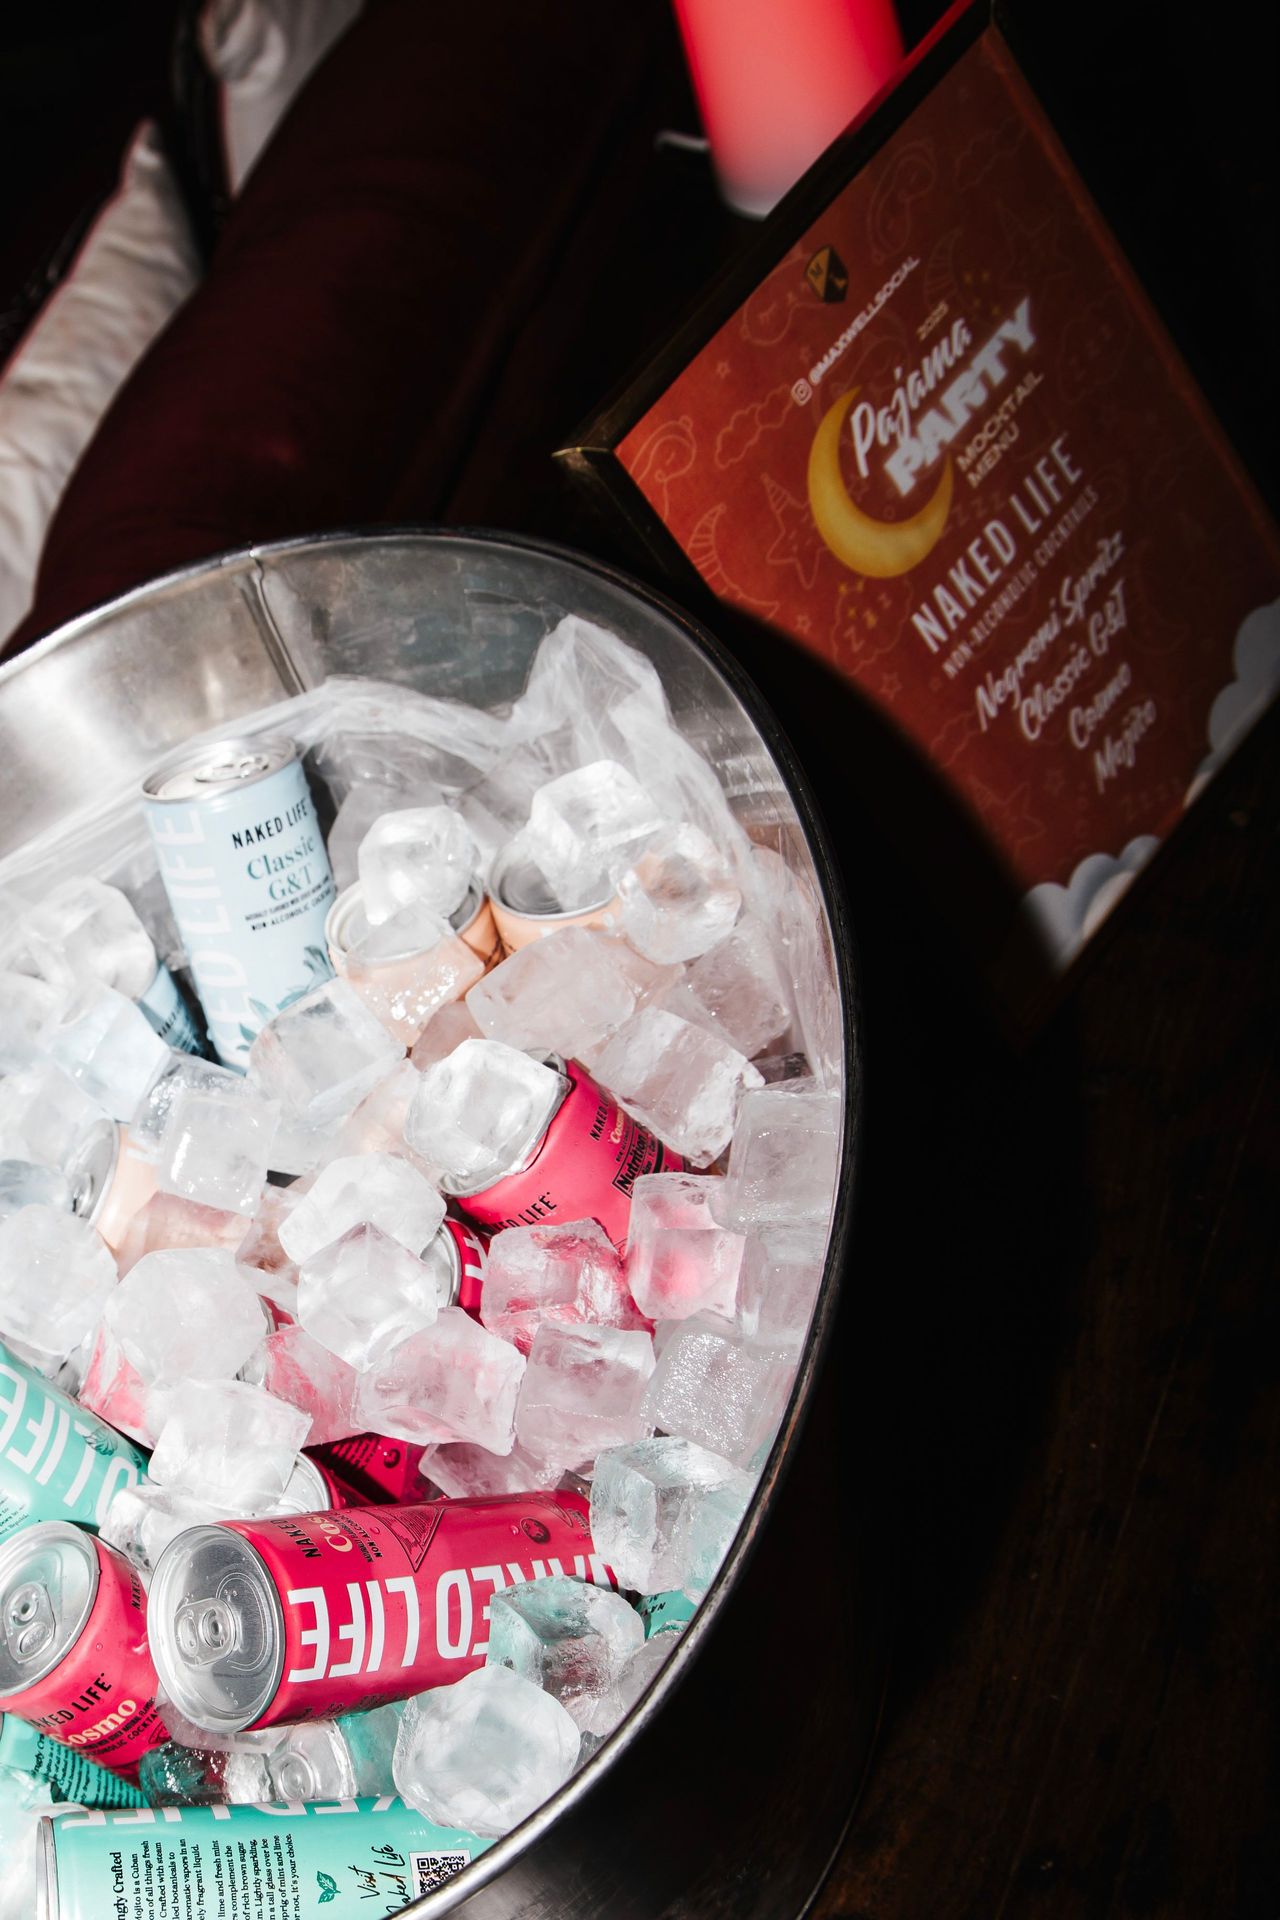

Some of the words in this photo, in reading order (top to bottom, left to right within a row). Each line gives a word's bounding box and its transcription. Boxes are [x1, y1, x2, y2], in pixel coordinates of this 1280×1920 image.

[850, 318, 972, 478] Pajama
[884, 296, 1036, 496] PARTY
[955, 372, 1044, 470] MOCKTAIL
[967, 423, 1020, 487] MENU
[911, 519, 1016, 654] NAKED
[1010, 437, 1082, 534] LIFE
[976, 598, 1060, 732] Negroni
[1020, 642, 1091, 741] Classic
[231, 815, 284, 850] NAKED
[285, 798, 309, 827] LIFE
[246, 835, 315, 880] Classic
[146, 808, 231, 935] LIFE
[268, 862, 313, 902] G&T
[616, 1134, 648, 1191] Nutrition
[518, 1195, 557, 1225] LIFE
[270, 1519, 322, 1559] NAKED
[287, 1576, 421, 1683] LIFE
[30, 1709, 75, 1729] AKED
[71, 1676, 113, 1713] LIFE
[127, 1709, 158, 1740] COCKTA
[141, 1840, 151, 1859] fresh
[155, 1842, 164, 1864] steam
[180, 1839, 186, 1847] an
[212, 1840, 220, 1857] mint
[225, 1845, 233, 1857] the
[237, 1841, 247, 1862] sugar
[273, 1835, 282, 1850] lime
[371, 1844, 405, 1867] Life
[131, 1853, 139, 1879] Cuban
[169, 1852, 175, 1860] to
[191, 1844, 202, 1868] liquid.
[213, 1858, 223, 1878] fresh
[263, 1850, 272, 1867] over
[274, 1851, 284, 1866] and
[290, 1859, 300, 1878] your
[109, 1852, 125, 1894] Crafted
[144, 1860, 153, 1885] things
[156, 1865, 165, 1883] with
[168, 1861, 179, 1904] botanicals
[182, 1856, 191, 1883] vapors
[240, 1863, 249, 1890] brown
[266, 1868, 276, 1890] glass
[278, 1867, 286, 1888] mint
[348, 1865, 380, 1899] Visit
[145, 1887, 154, 1897] all
[195, 1869, 205, 1906] fragrant
[215, 1880, 224, 1896] and
[228, 1859, 239, 1911] complement
[253, 1877, 264, 1907] Lightly
[278, 1888, 286, 1897] of
[291, 1879, 299, 1893] it's
[146, 1898, 154, 1908] of
[157, 1885, 168, 1918] Crafted
[218, 1898, 226, 1917] lime
[241, 1893, 250, 1910] rich
[266, 1892, 275, 1906] tall
